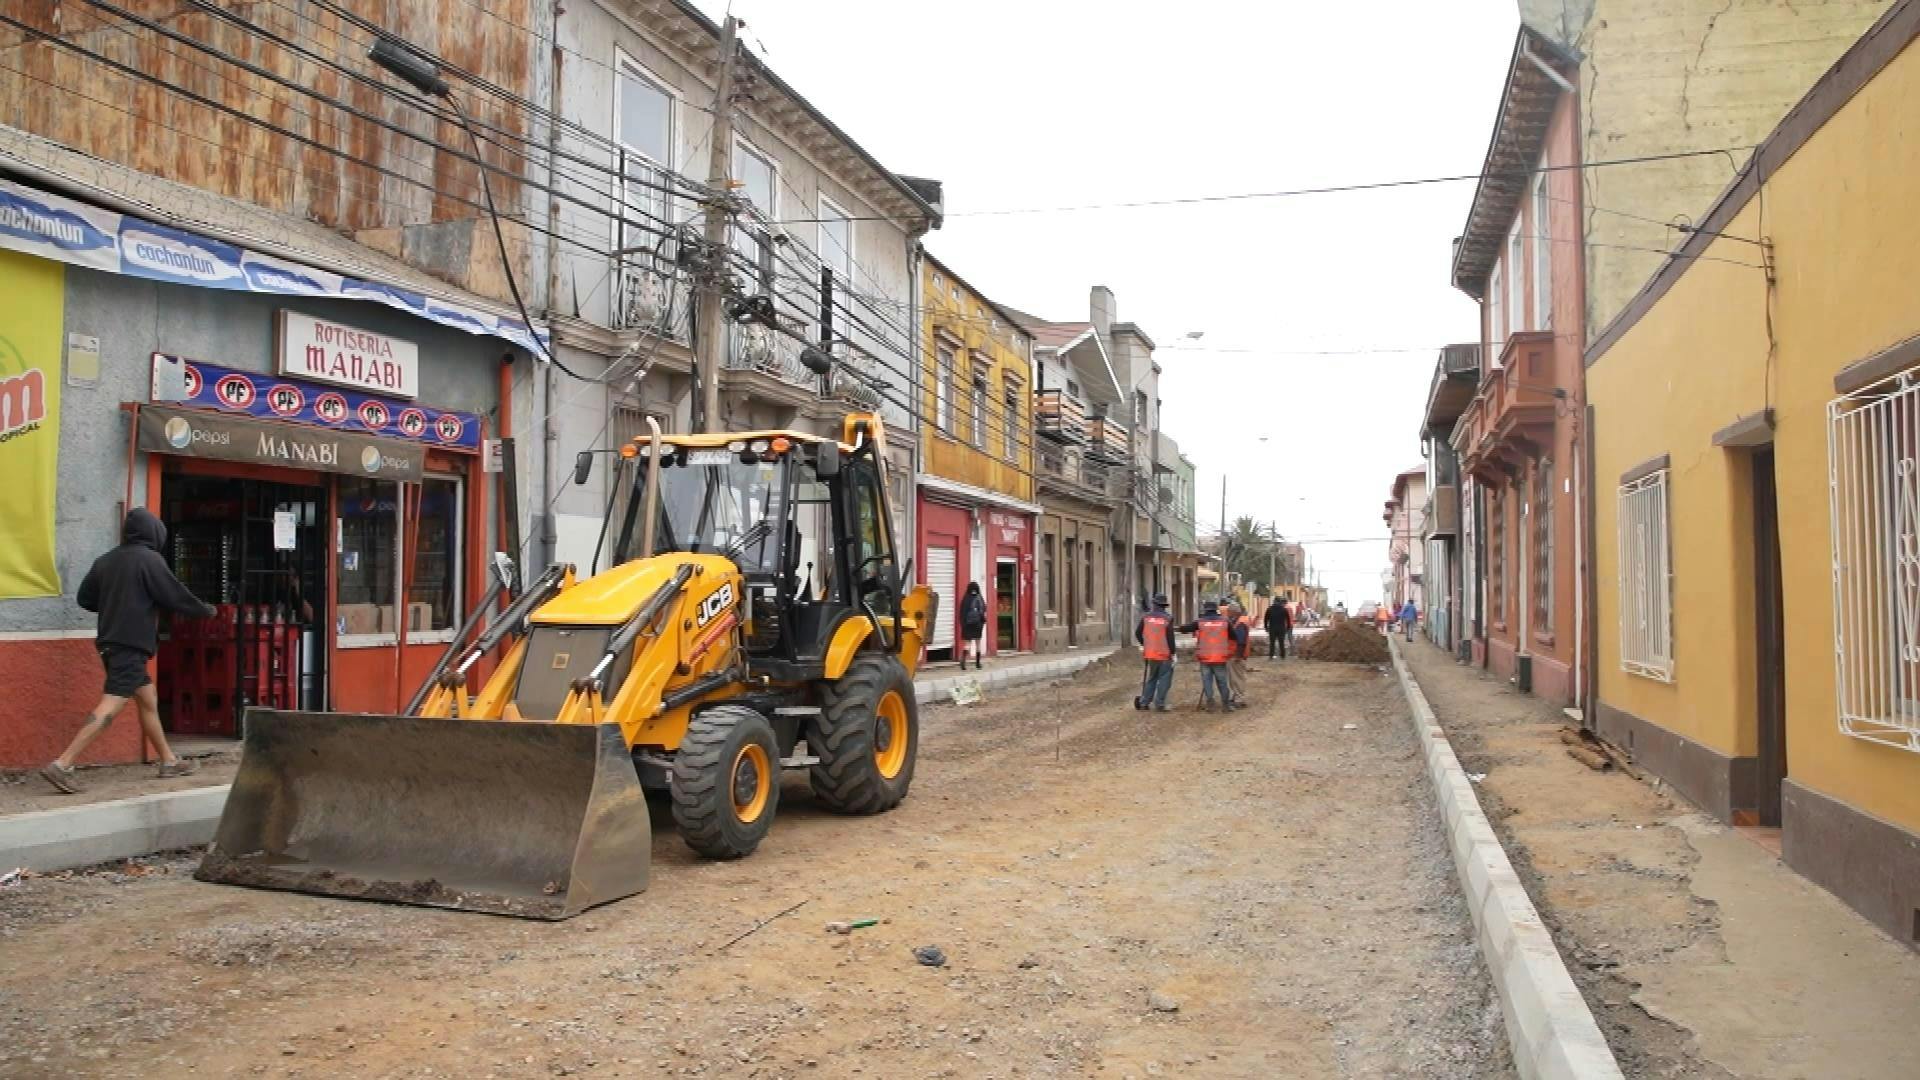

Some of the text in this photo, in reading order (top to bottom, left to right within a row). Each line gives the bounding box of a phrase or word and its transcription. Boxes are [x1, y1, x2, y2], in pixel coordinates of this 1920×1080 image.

[136, 243, 216, 275] cachantun
[314, 321, 393, 358] ROTISERIA
[305, 343, 403, 389] MANABI
[192, 429, 230, 445] pepsi
[256, 431, 338, 465] MANABI
[697, 582, 733, 627] JCB
